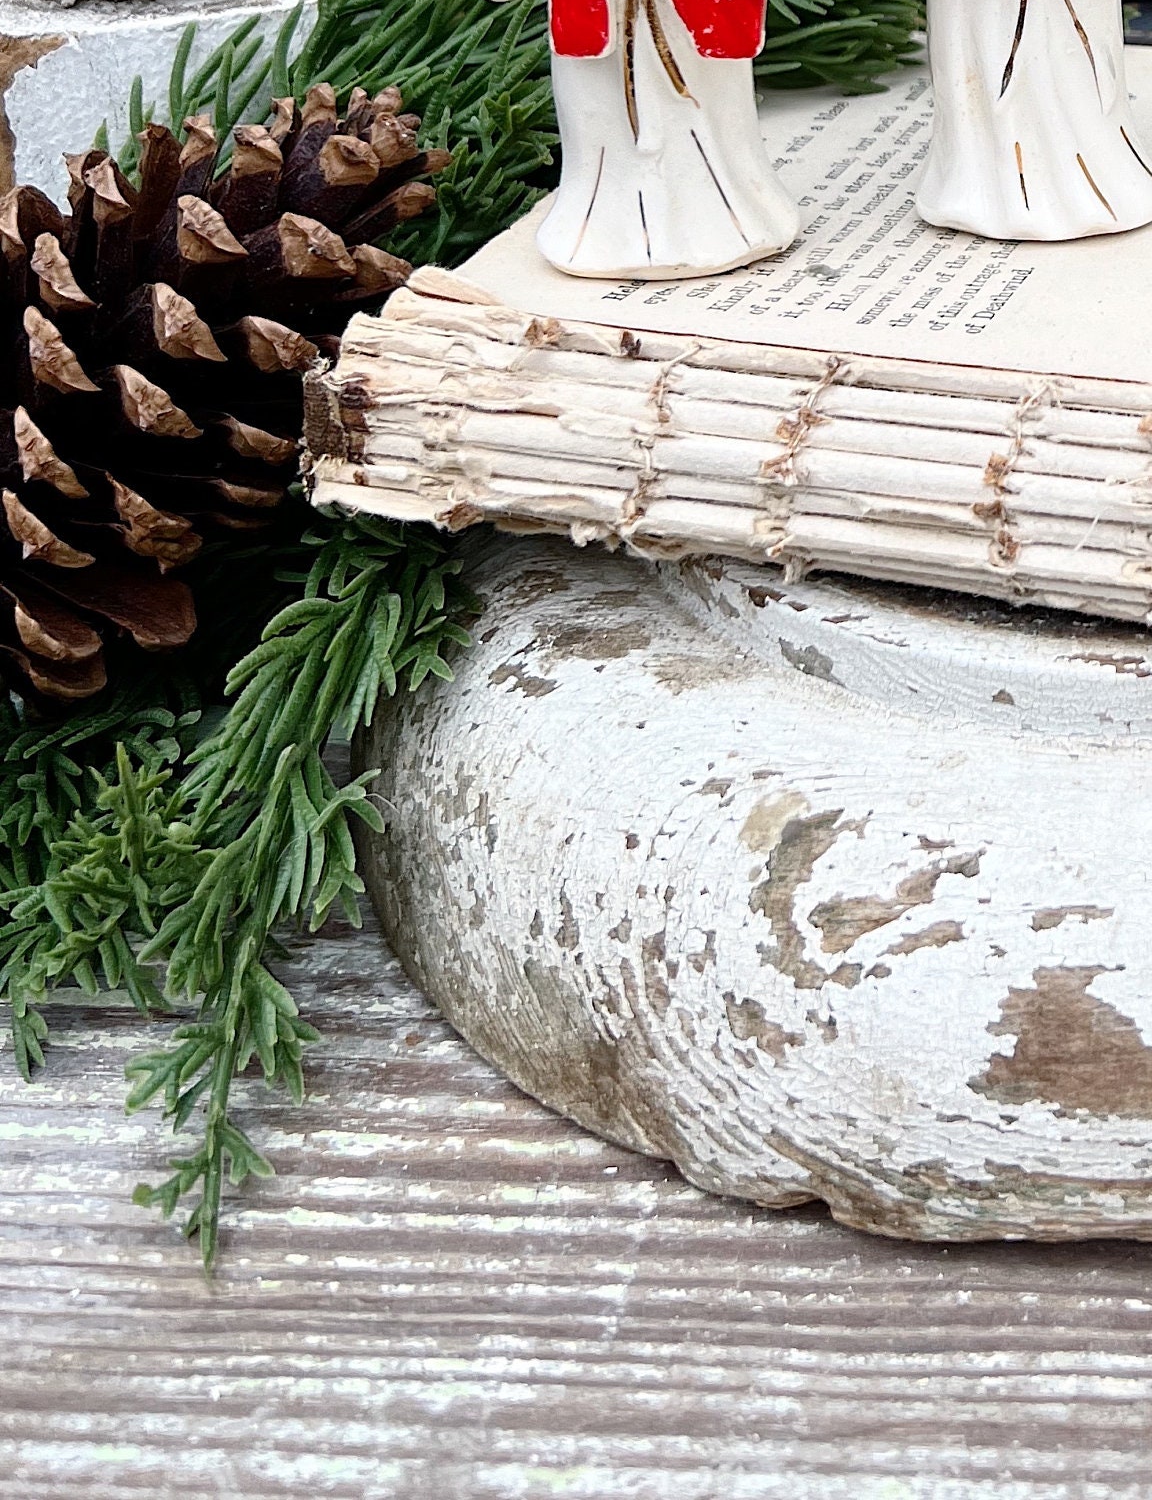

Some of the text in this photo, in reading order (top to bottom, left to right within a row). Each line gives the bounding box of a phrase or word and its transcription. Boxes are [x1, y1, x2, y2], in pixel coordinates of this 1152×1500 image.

[706, 280, 762, 312] Kindly
[750, 268, 776, 277] it
[803, 214, 831, 235] over
[823, 195, 850, 211] the
[845, 172, 876, 194] stern
[894, 119, 928, 145] giving
[686, 281, 722, 299] She
[814, 183, 829, 191] a
[749, 304, 771, 316] of
[827, 218, 863, 244] warm
[851, 182, 899, 216] beneath
[889, 163, 918, 179] that
[909, 242, 951, 273] among
[945, 254, 972, 269] the
[601, 279, 649, 301] Hele
[778, 309, 810, 319] it,
[797, 290, 831, 307] too,
[847, 243, 874, 262] was
[936, 271, 956, 284] of
[959, 261, 1007, 300] outrage,
[911, 286, 944, 309] moss
[937, 300, 968, 318] this
[964, 267, 1036, 335] of Deathwind.
[888, 311, 918, 328] the
[928, 320, 950, 332] of
